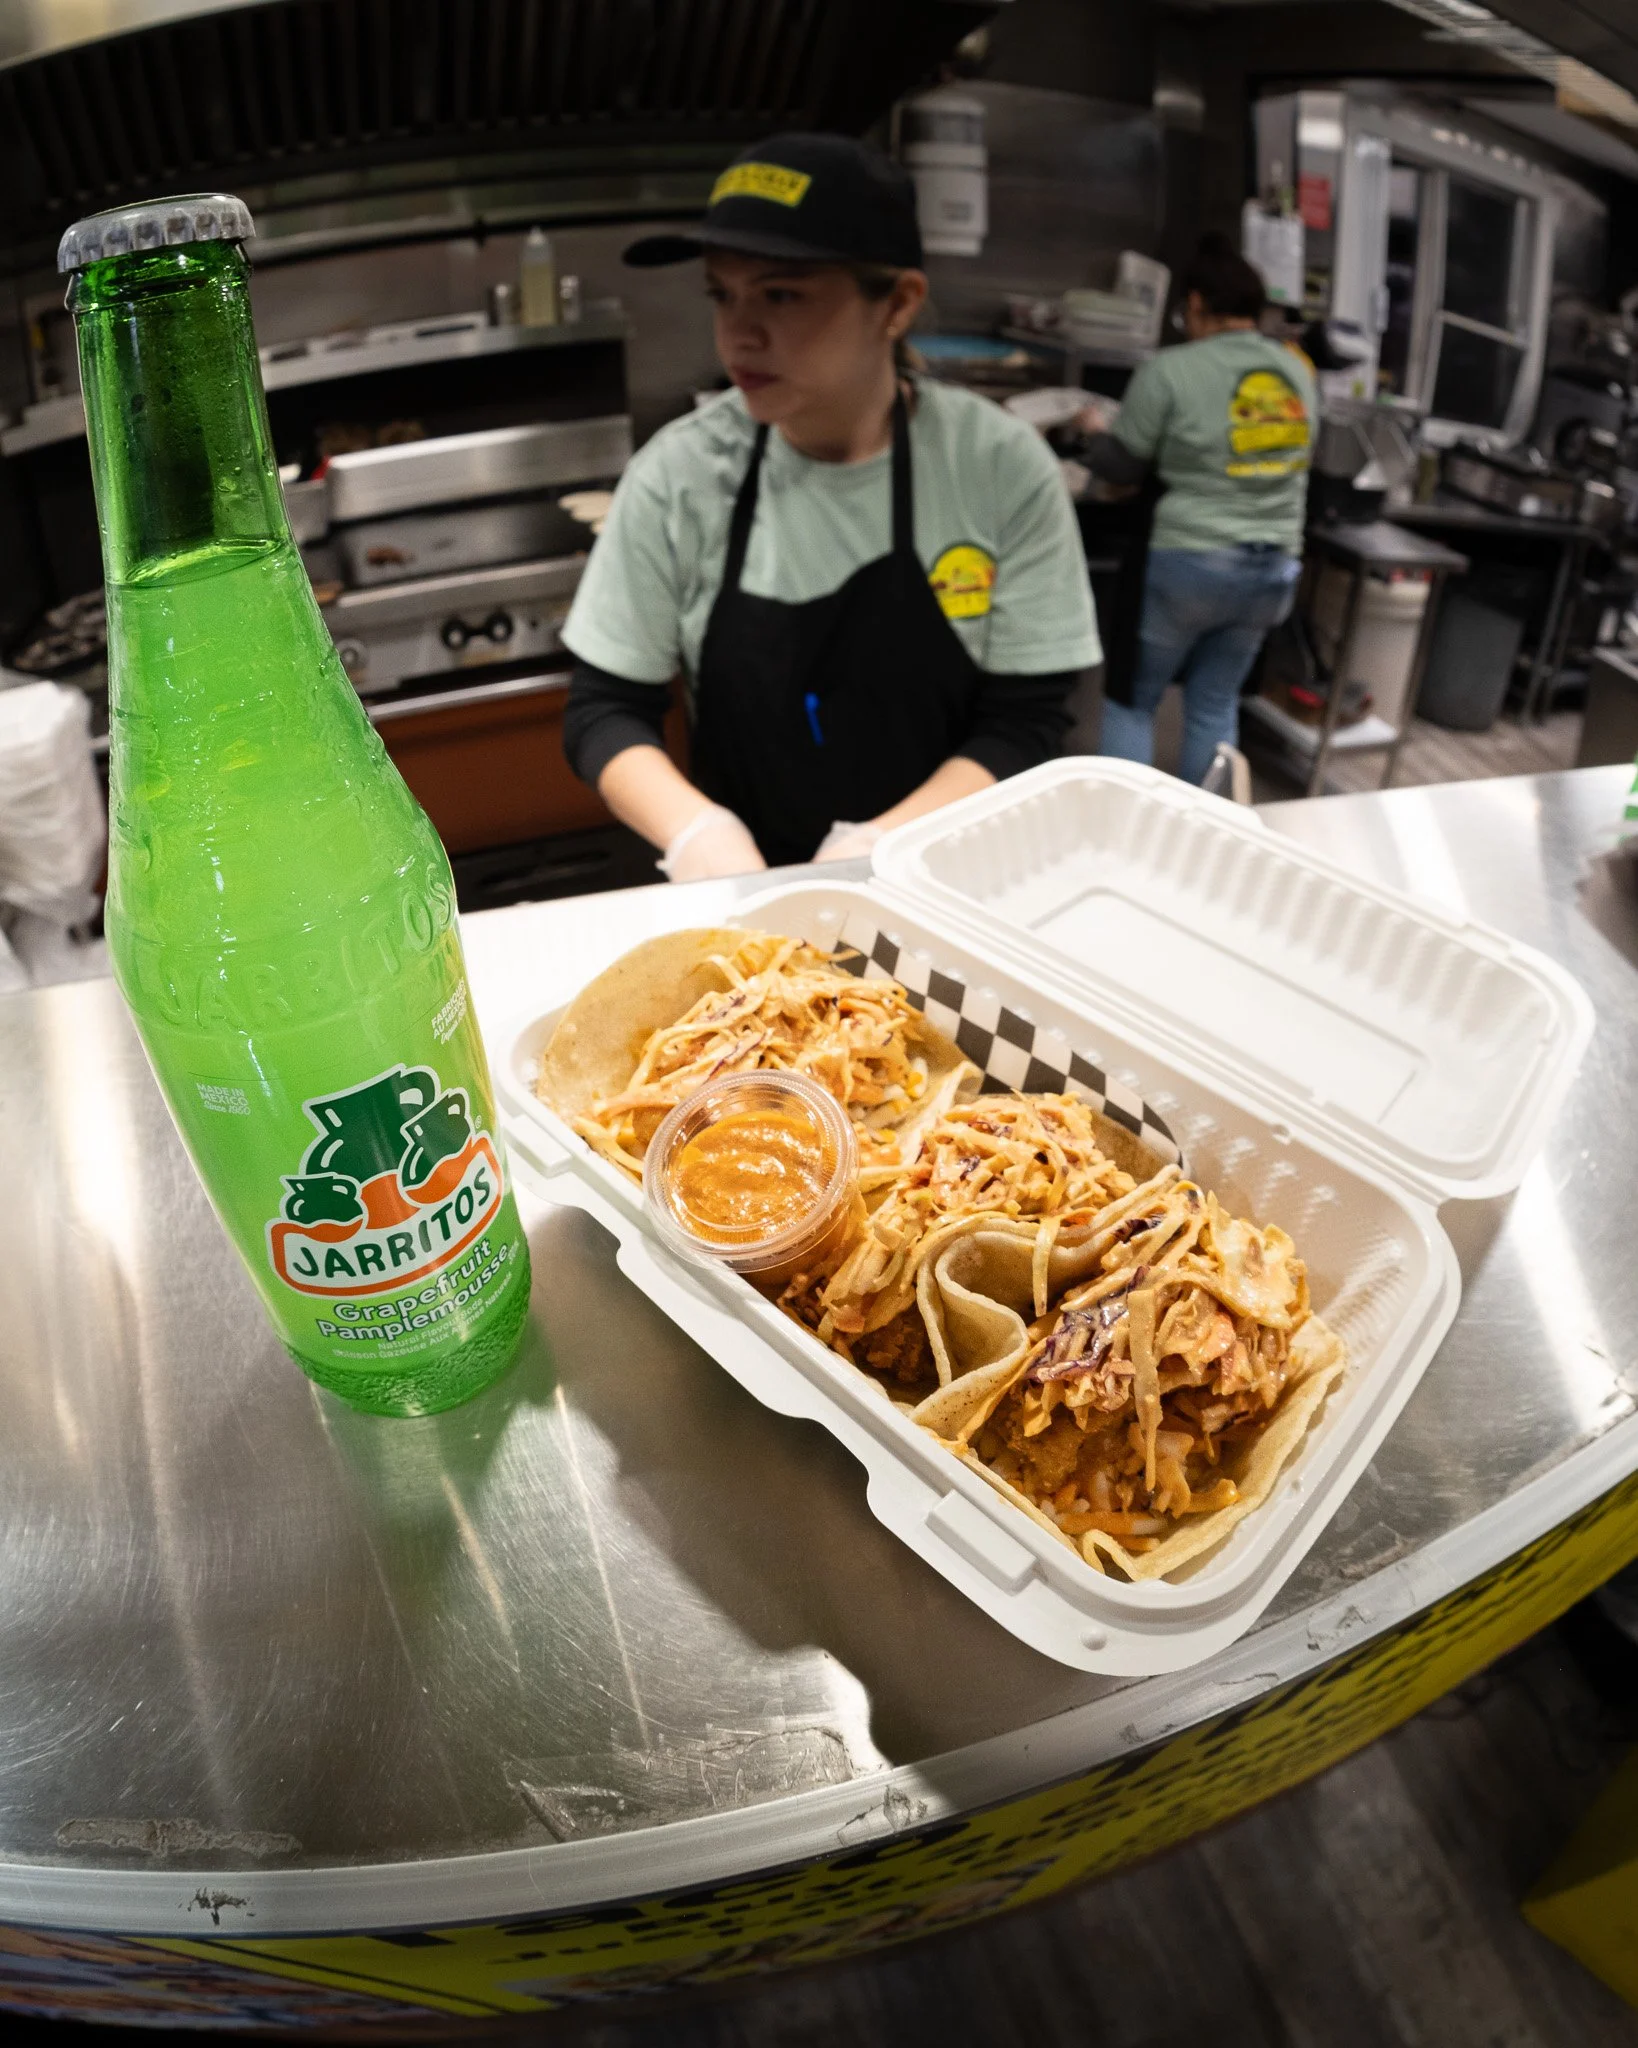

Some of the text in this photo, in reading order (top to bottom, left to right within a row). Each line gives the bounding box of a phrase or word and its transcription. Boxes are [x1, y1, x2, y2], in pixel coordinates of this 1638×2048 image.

[196, 1082, 245, 1098] MADE IN
[199, 1091, 249, 1107] MEXICO
[292, 1166, 491, 1279] JARRITOS
[316, 1243, 509, 1342] Pamplemousse
[333, 1237, 492, 1323] Grapefruit
[378, 1334, 420, 1351] Natural
